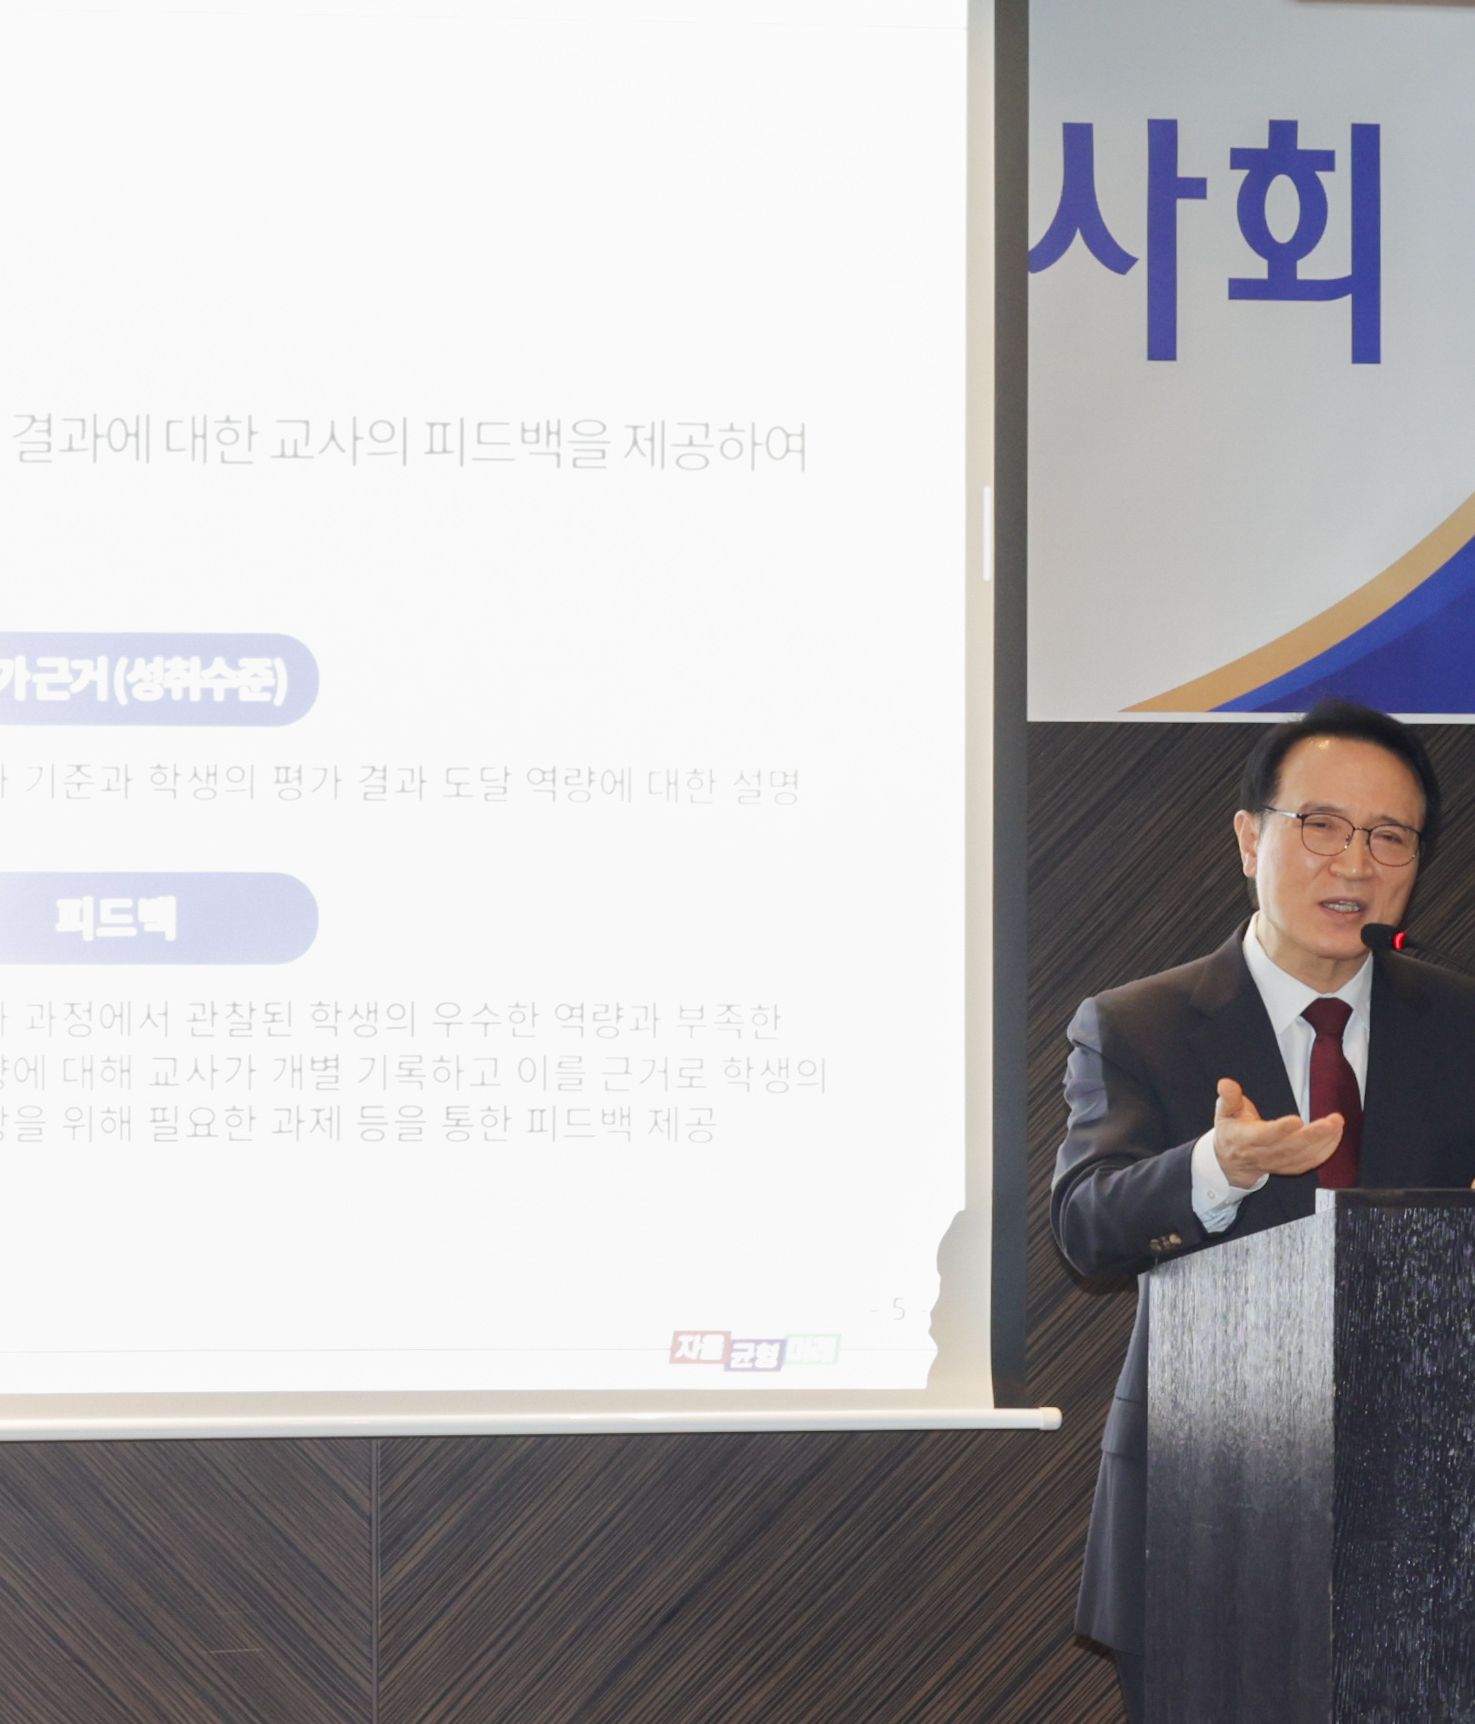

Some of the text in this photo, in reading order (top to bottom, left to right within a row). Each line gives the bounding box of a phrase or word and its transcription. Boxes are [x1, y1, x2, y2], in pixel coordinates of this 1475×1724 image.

[13, 413, 150, 464] 결과에
[166, 414, 258, 464] 대한
[271, 416, 407, 467] 교사의
[424, 417, 611, 469] 피드백을
[624, 420, 805, 472] 제공하여
[26, 763, 133, 799] 기준과
[149, 763, 254, 800] 학생의
[274, 764, 342, 800] 평가
[359, 765, 427, 801] 결과
[443, 766, 511, 802] 도달
[527, 766, 631, 803] 역량에
[648, 768, 716, 804] 대한
[733, 769, 798, 805] 설명
[55, 896, 176, 941] 피드백
[26, 1001, 168, 1037] 과정에서
[187, 1001, 292, 1037] 관찰된
[311, 1001, 414, 1037] 학생의
[433, 1002, 539, 1037] 우수한
[555, 1002, 660, 1039] 역량과
[677, 1004, 781, 1040] 부족한
[63, 1055, 131, 1090] 대해
[149, 1054, 256, 1090] 교사가
[273, 1054, 339, 1090] 개별
[358, 1055, 501, 1090] 기록하고
[518, 1055, 585, 1091] 이를
[602, 1056, 706, 1092] 근거로
[724, 1056, 825, 1094] 학생의
[63, 1106, 131, 1142] 위해
[149, 1105, 256, 1142] 필요한
[272, 1105, 340, 1141] 과제
[357, 1105, 426, 1142] 등을
[442, 1105, 511, 1142] 통한
[526, 1106, 631, 1142] 피드백
[648, 1107, 716, 1143] 제공
[893, 1298, 905, 1320] 5
